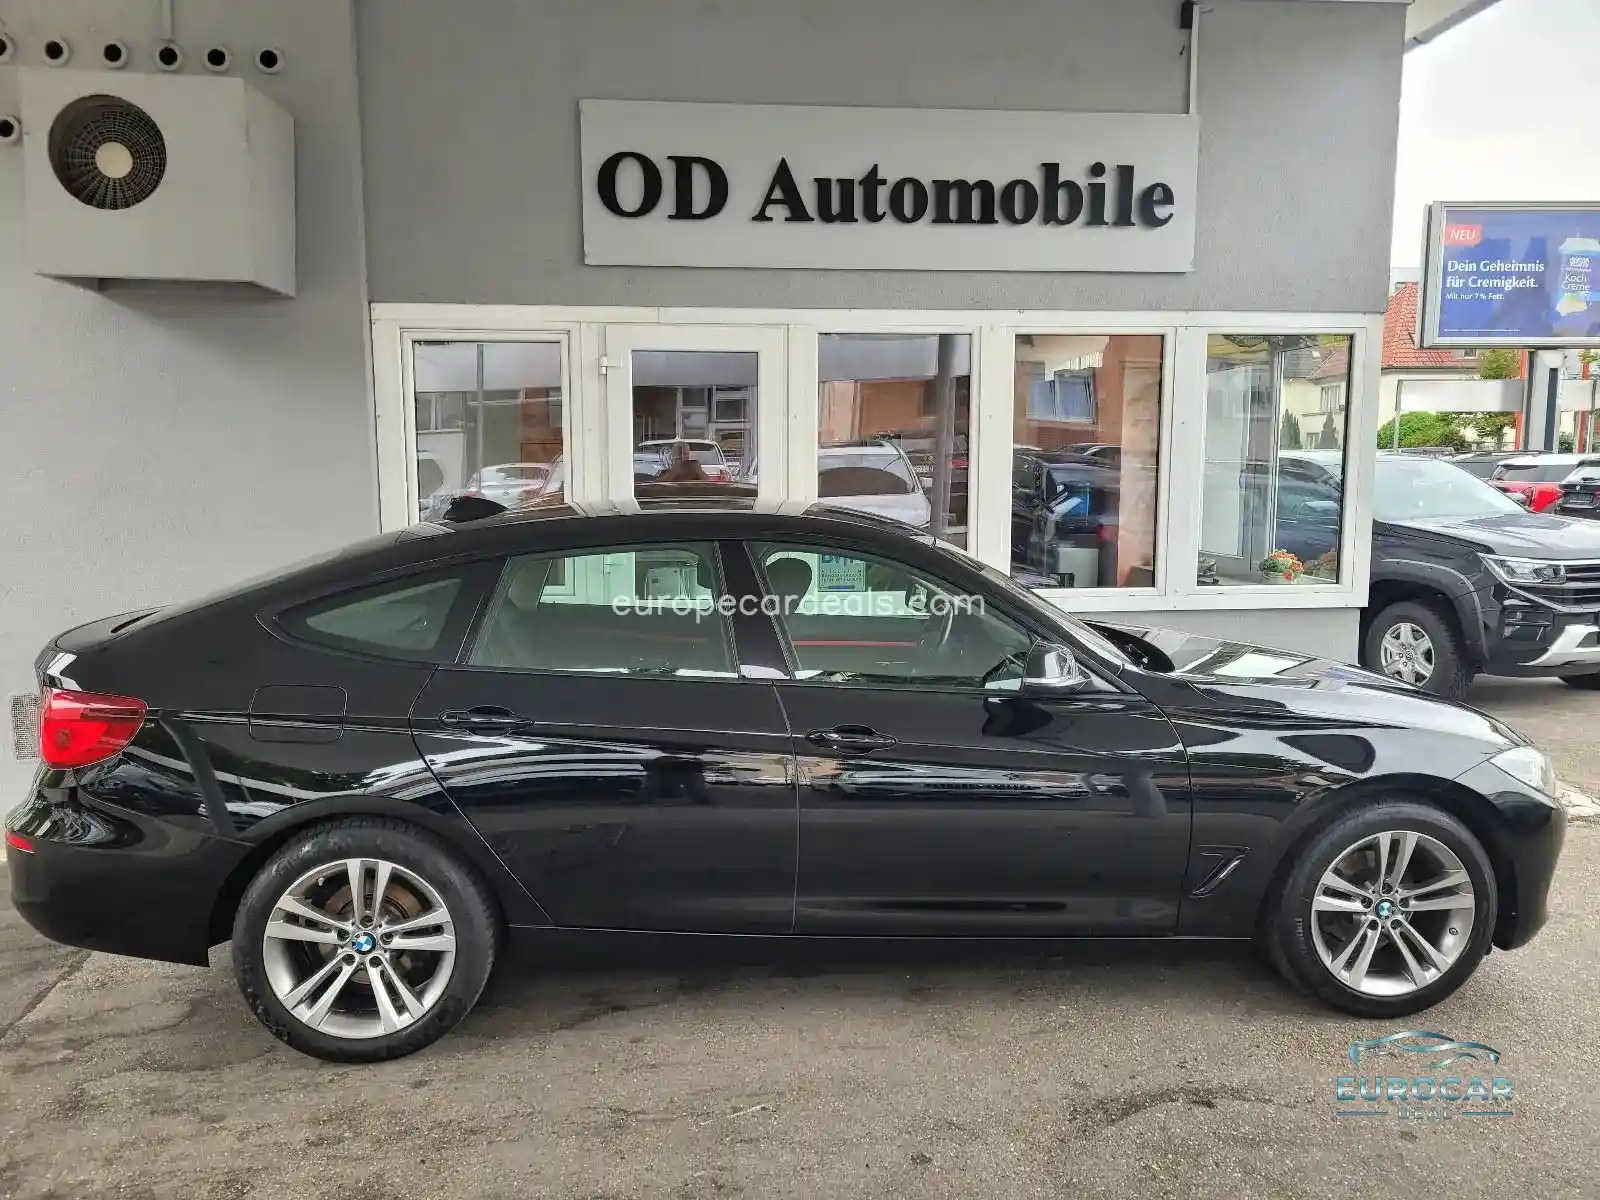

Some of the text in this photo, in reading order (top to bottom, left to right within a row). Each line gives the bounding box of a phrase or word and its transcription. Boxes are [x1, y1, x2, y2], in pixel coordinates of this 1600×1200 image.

[597, 151, 1175, 228] OD Automobile
[1450, 229, 1476, 241] NEU
[1447, 259, 1545, 272] Dein Geheimnis
[1446, 275, 1539, 291] für Cremigkeit.
